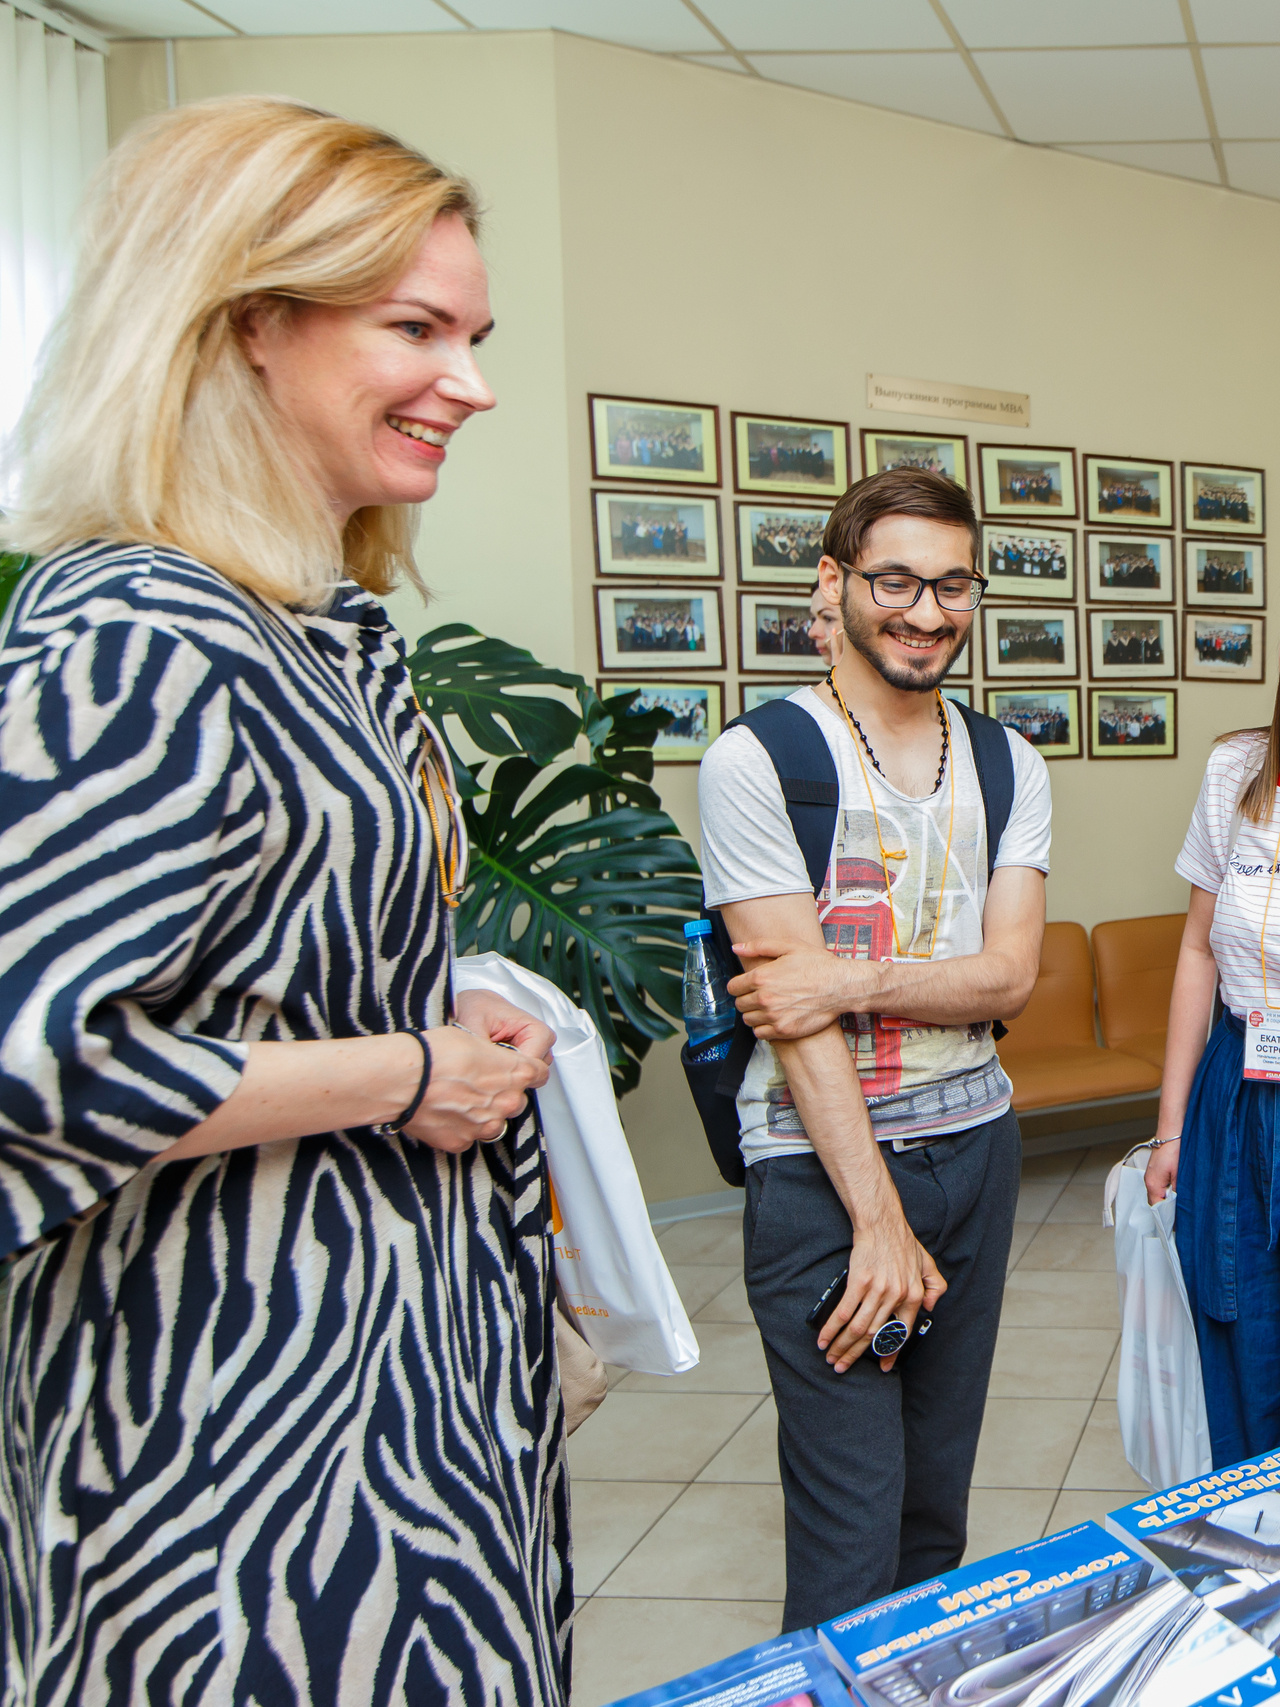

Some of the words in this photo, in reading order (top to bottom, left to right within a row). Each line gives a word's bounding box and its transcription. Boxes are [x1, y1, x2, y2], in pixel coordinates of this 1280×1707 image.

[874, 386, 939, 402] Выпускники
[942, 394, 997, 411] программы
[854, 1551, 1130, 1667] КОРПОРАТИВНЫЕ
[938, 1569, 1032, 1613] СМИ
